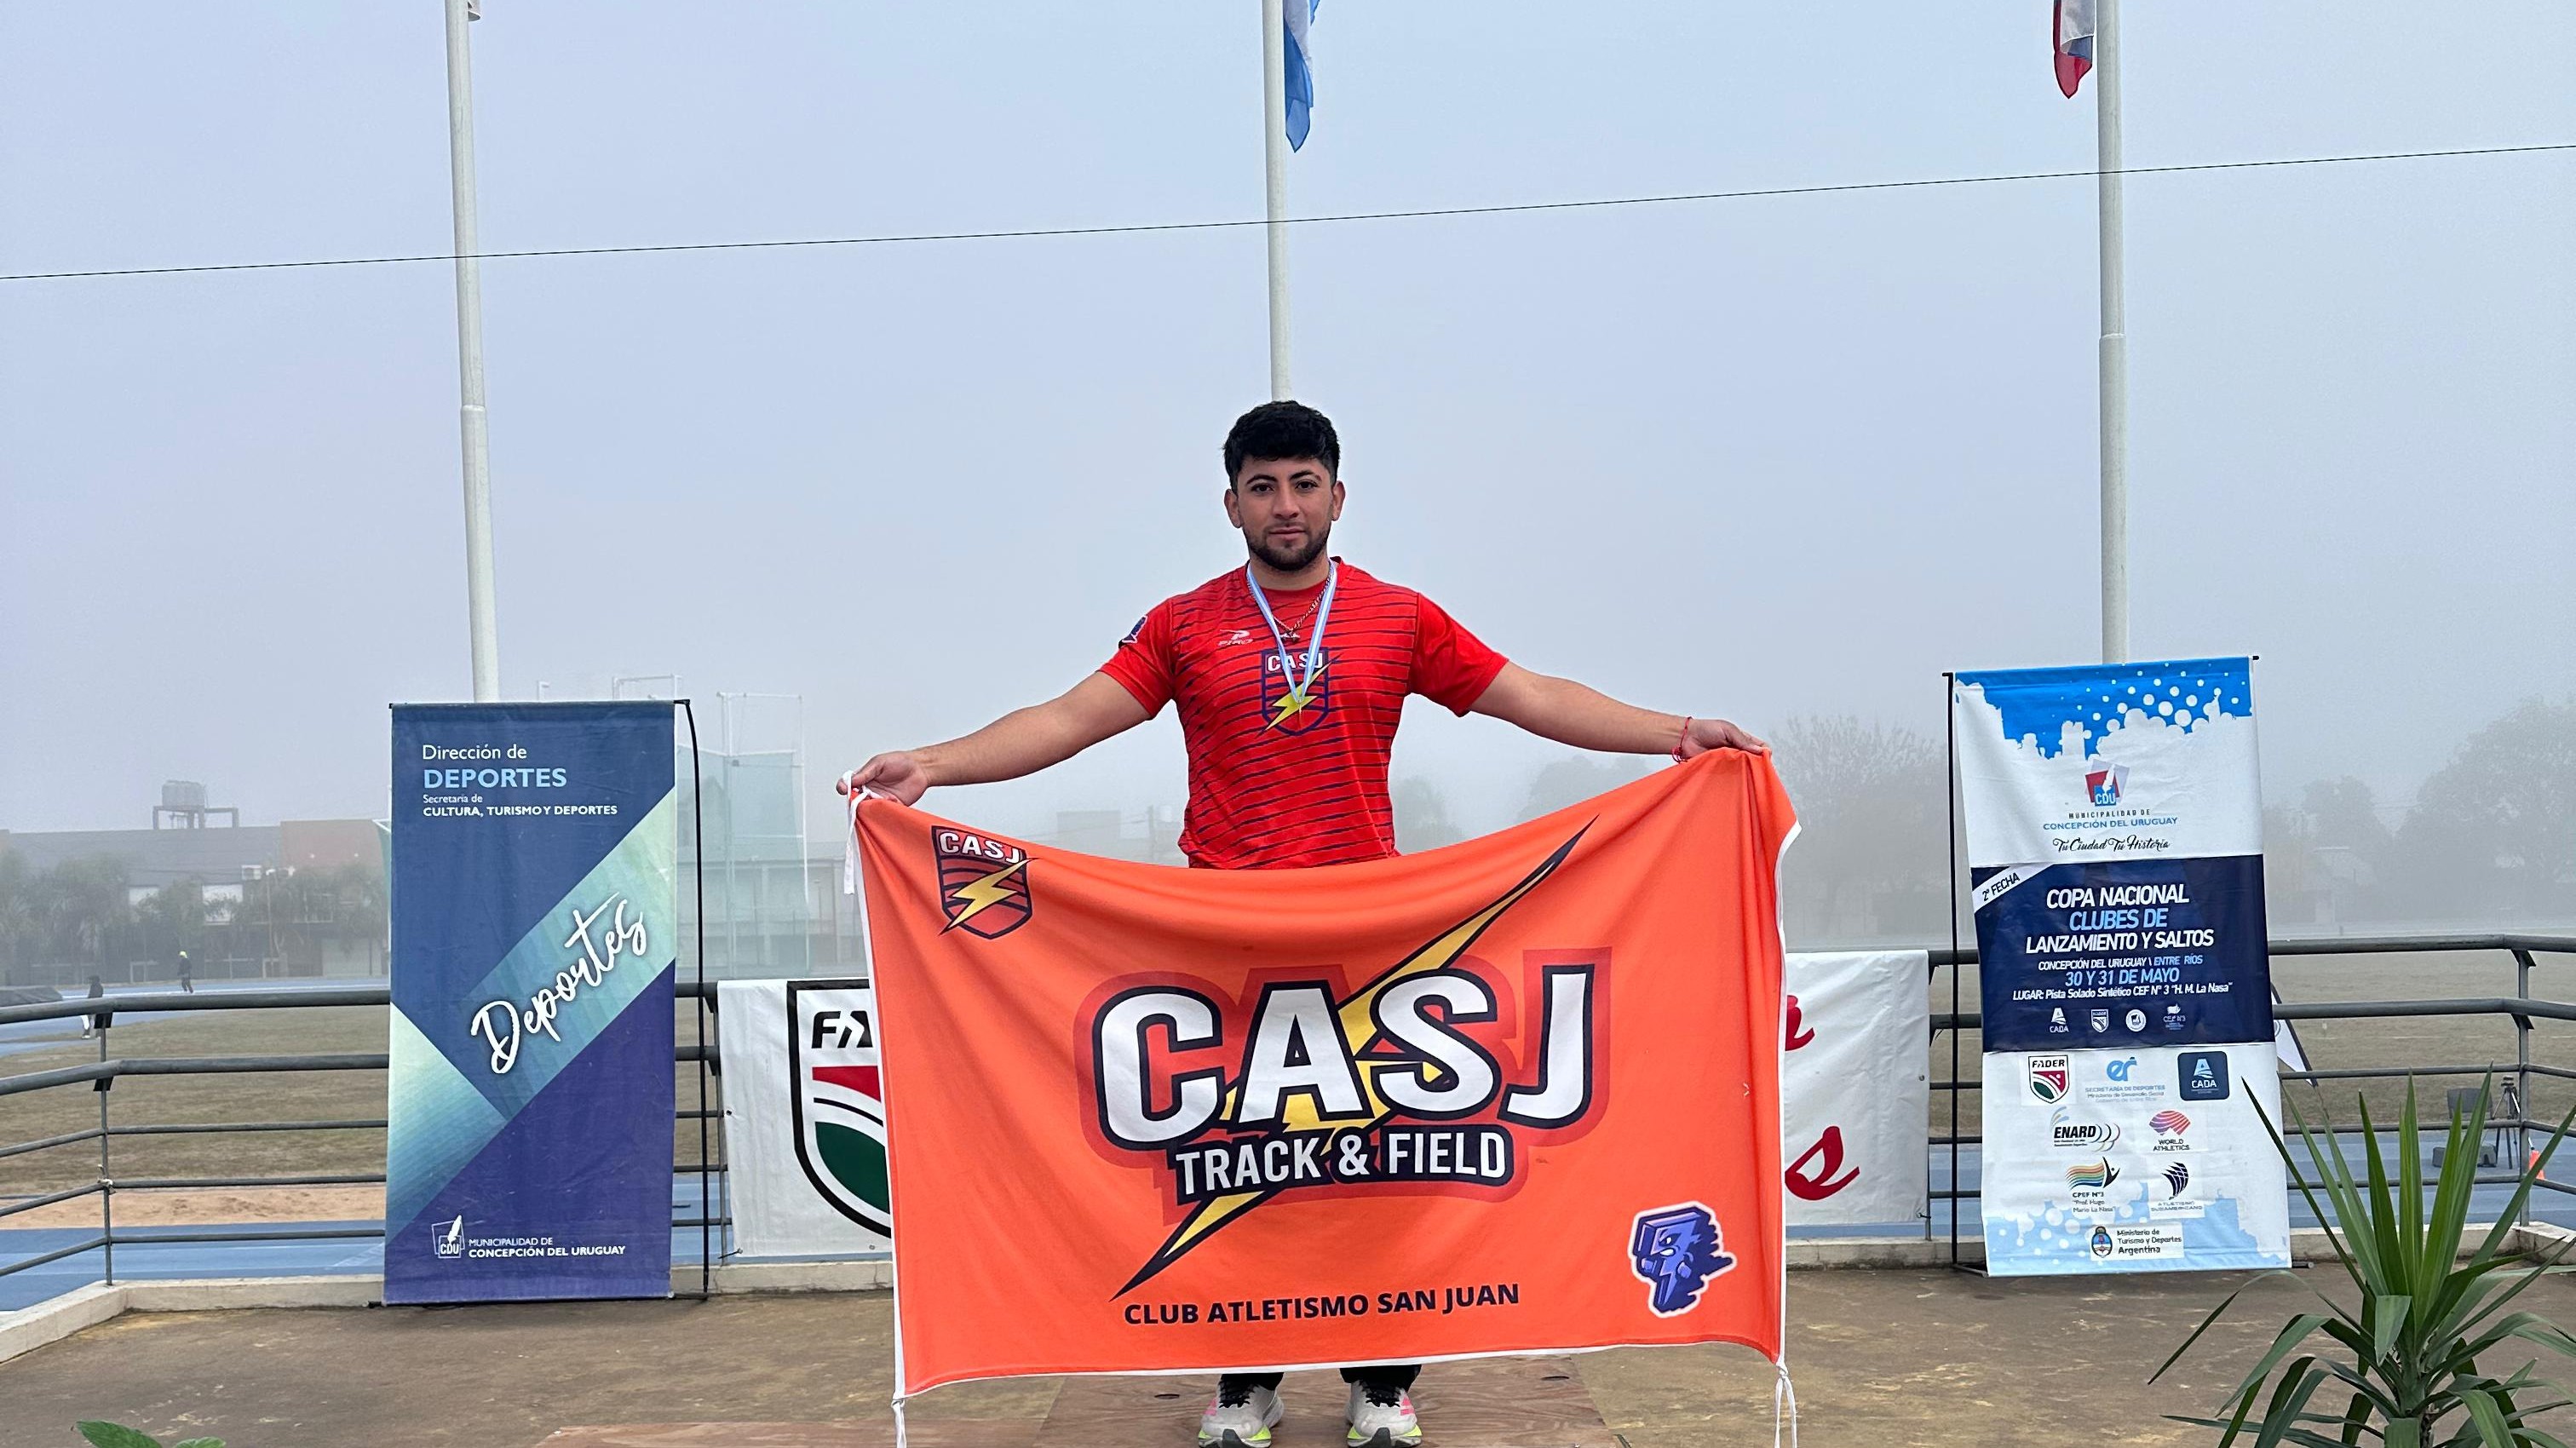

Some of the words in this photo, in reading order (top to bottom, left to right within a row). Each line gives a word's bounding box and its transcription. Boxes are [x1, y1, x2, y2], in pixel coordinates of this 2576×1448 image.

[423, 744, 501, 760] Dirección
[507, 744, 527, 759] de
[423, 767, 567, 789] DEPORTES
[471, 794, 483, 803] de
[2096, 793, 2116, 804] CDU
[423, 806, 484, 818] CULTURA,
[486, 806, 542, 816] TURISMO
[543, 806, 551, 815] Y
[555, 805, 618, 815] DEPORTES
[2044, 819, 2107, 830] CONCEPCIÓN
[2131, 817, 2178, 826] URUGUAY
[939, 832, 1021, 864] CASJ
[2052, 837, 2069, 853] Tu
[2070, 836, 2108, 851] Ciudad
[2108, 837, 2125, 852] Tu
[2126, 834, 2170, 852] Historia
[1991, 872, 2021, 895] FECHA
[2046, 888, 2096, 909] COPA
[2099, 883, 2189, 907] NACIONAL
[2069, 909, 2139, 931] CLUBES
[2143, 908, 2169, 928] DE
[2026, 932, 2138, 954] LANZAMIENTO
[2141, 932, 2153, 949] Y
[2154, 928, 2215, 949] SALTOS
[2038, 957, 2090, 970] CONCEPCIÓN
[2090, 959, 2107, 968] DEL
[2108, 957, 2147, 968] URUGUAY
[2153, 956, 2181, 966] ENTRE
[2184, 953, 2203, 964] RÍOS
[470, 892, 647, 1074] Deportes
[2065, 971, 2083, 986] 30
[2086, 970, 2096, 985] Y
[2098, 970, 2113, 985] 31
[2119, 968, 2138, 984] DE
[2141, 968, 2180, 983] MAYO
[2013, 990, 2044, 1000] LUGAR:
[2045, 989, 2066, 999] Pista
[2067, 988, 2096, 998] Solado
[2097, 986, 2131, 997] Sintético
[2133, 985, 2149, 996] CEF
[2164, 985, 2169, 994] 3
[2196, 984, 2206, 993] La
[1096, 967, 1592, 1148] CASJ
[2033, 1060, 2065, 1068] FADER
[2191, 1079, 2217, 1089] CADA
[2054, 1126, 2096, 1138] ENARD
[1176, 1137, 1321, 1195] TRACK
[1338, 1135, 1370, 1175] &
[1389, 1132, 1506, 1178] FIELD
[440, 1243, 461, 1255] CDU
[469, 1238, 538, 1246] MUNICIPALIDAD
[469, 1246, 544, 1258] CONCEPCIÓN
[548, 1248, 568, 1256] DEL
[571, 1246, 625, 1256] URUGUAY
[2119, 1245, 2160, 1256] Argentina
[1124, 1303, 1199, 1324] CLUB
[1206, 1294, 1369, 1323] ATLETISMO
[1377, 1290, 1436, 1313] SAN
[1443, 1283, 1520, 1314] JUAN
